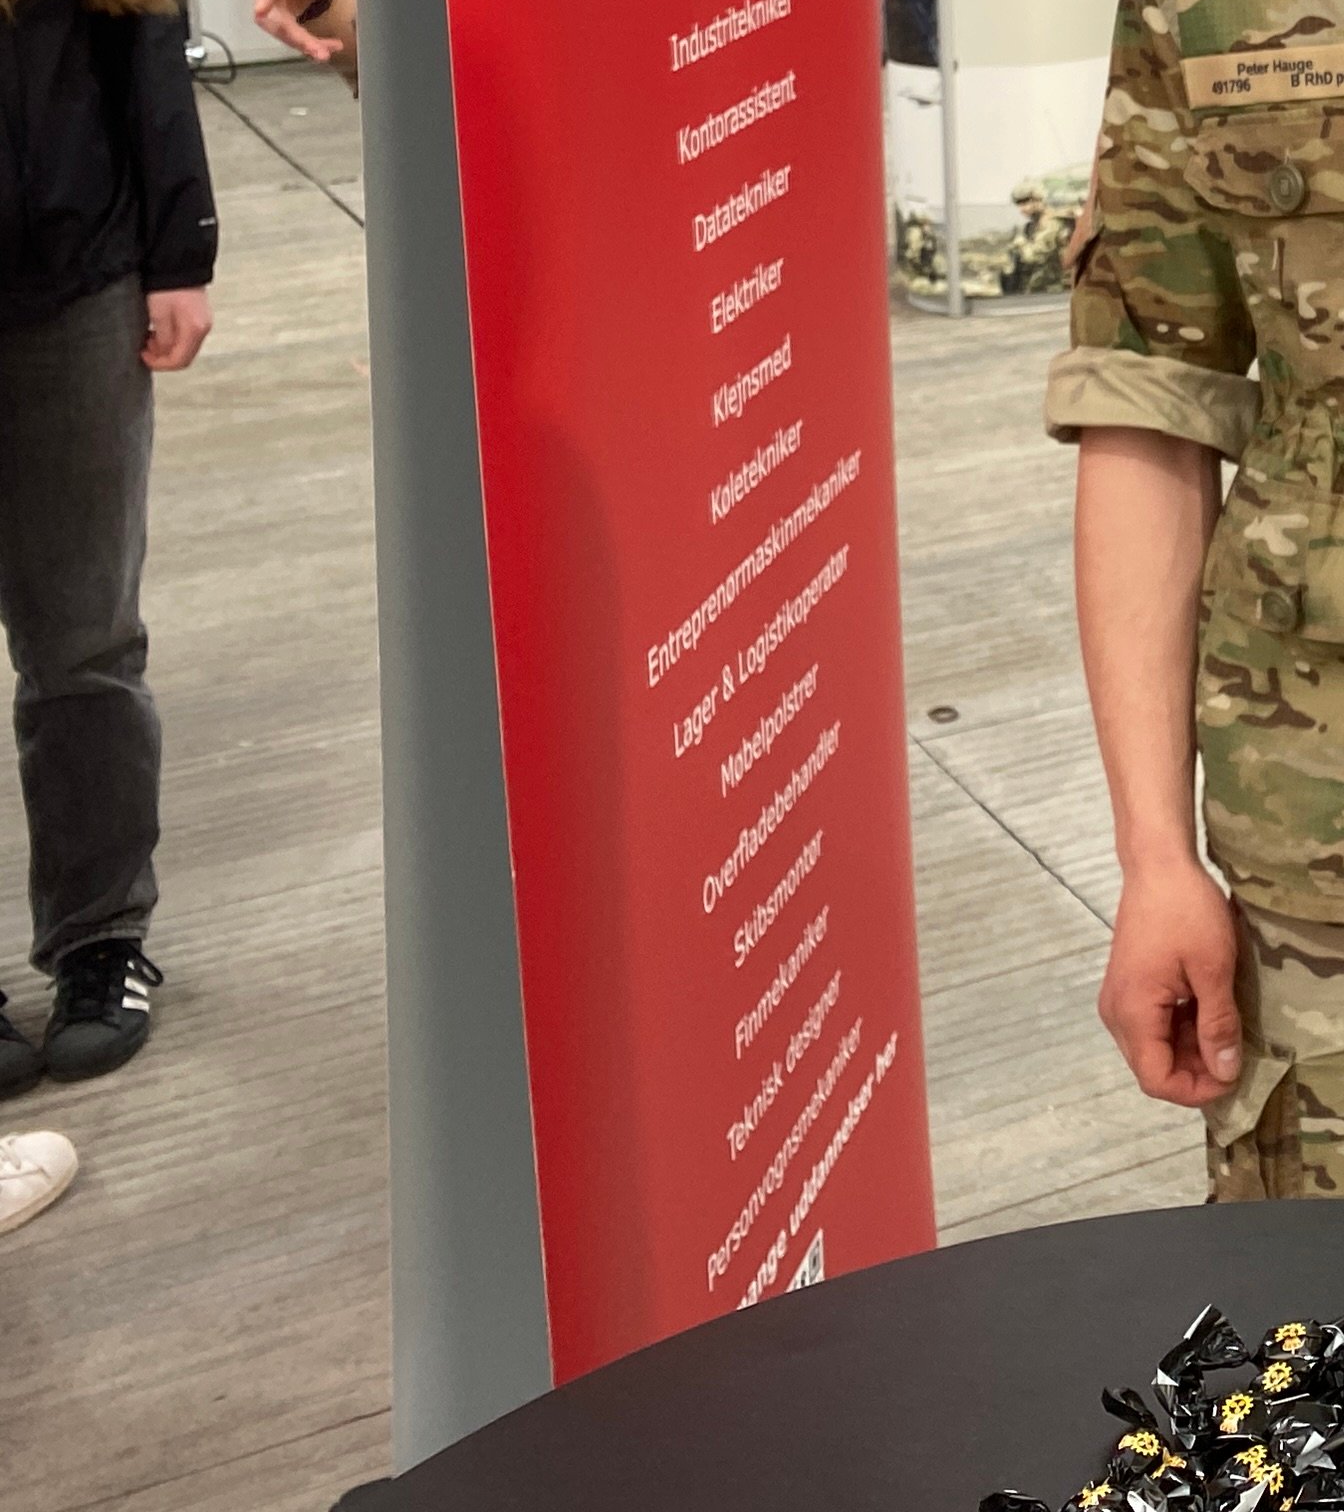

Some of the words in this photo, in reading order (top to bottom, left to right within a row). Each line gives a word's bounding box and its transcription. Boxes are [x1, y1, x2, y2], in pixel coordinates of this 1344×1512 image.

[677, 70, 797, 164] Kontorassistent
[1237, 62, 1269, 76] Peter
[1273, 59, 1313, 75] Hauge
[1291, 73, 1300, 87] B
[1305, 71, 1333, 86] RhD
[693, 164, 791, 252] Datatekniker
[711, 258, 784, 334] Elektriker
[712, 333, 791, 427] Klejnsmed
[710, 419, 803, 525] Køletekniker
[647, 448, 861, 689] Entreprenørmaskinmekaniker
[673, 685, 718, 758] Lager
[721, 663, 736, 702] &
[720, 662, 820, 798] Møbelpolstrer
[702, 720, 841, 914] Overfladebehandler
[733, 829, 824, 968] Skibsmontør
[735, 904, 829, 1060] Finmekaniker
[726, 1060, 784, 1161] Teknisk
[784, 969, 842, 1074] designer
[707, 1016, 863, 1292] Personvognsmekaniker
[737, 1229, 787, 1310] ange
[788, 1071, 874, 1237] uddannelser
[874, 1029, 898, 1085] her
